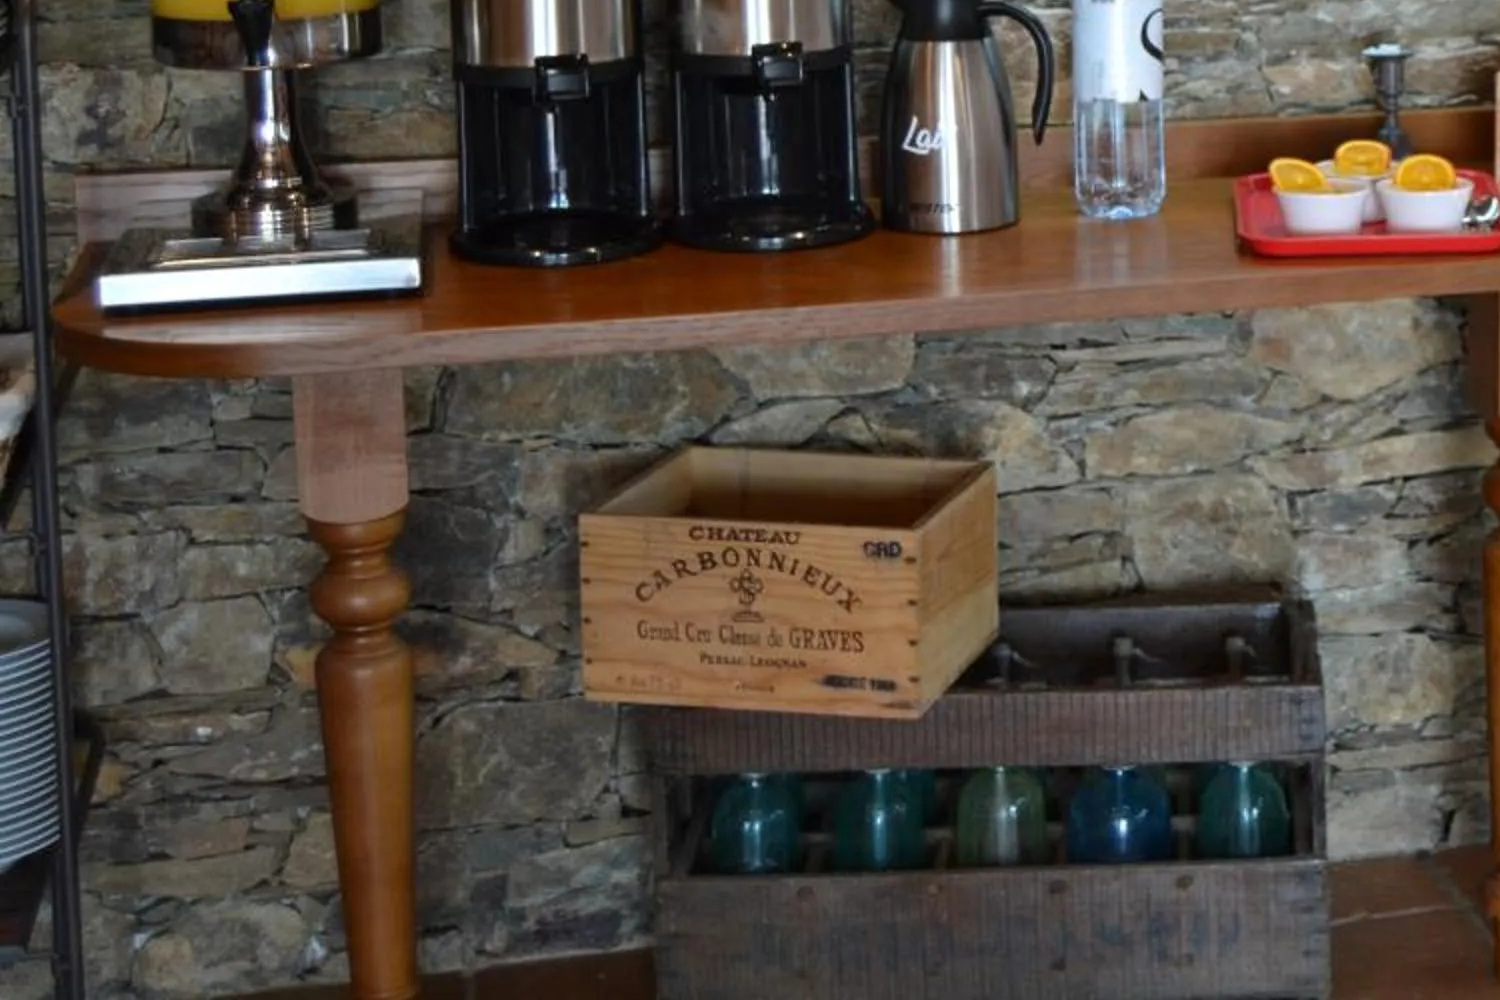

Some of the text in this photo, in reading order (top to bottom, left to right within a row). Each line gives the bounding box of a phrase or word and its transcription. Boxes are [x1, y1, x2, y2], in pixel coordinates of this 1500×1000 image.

[688, 525, 801, 546] CHATEAU
[634, 546, 863, 614] CARBONNIEUX
[636, 619, 680, 643] Grand
[788, 626, 865, 654] GRAVES
